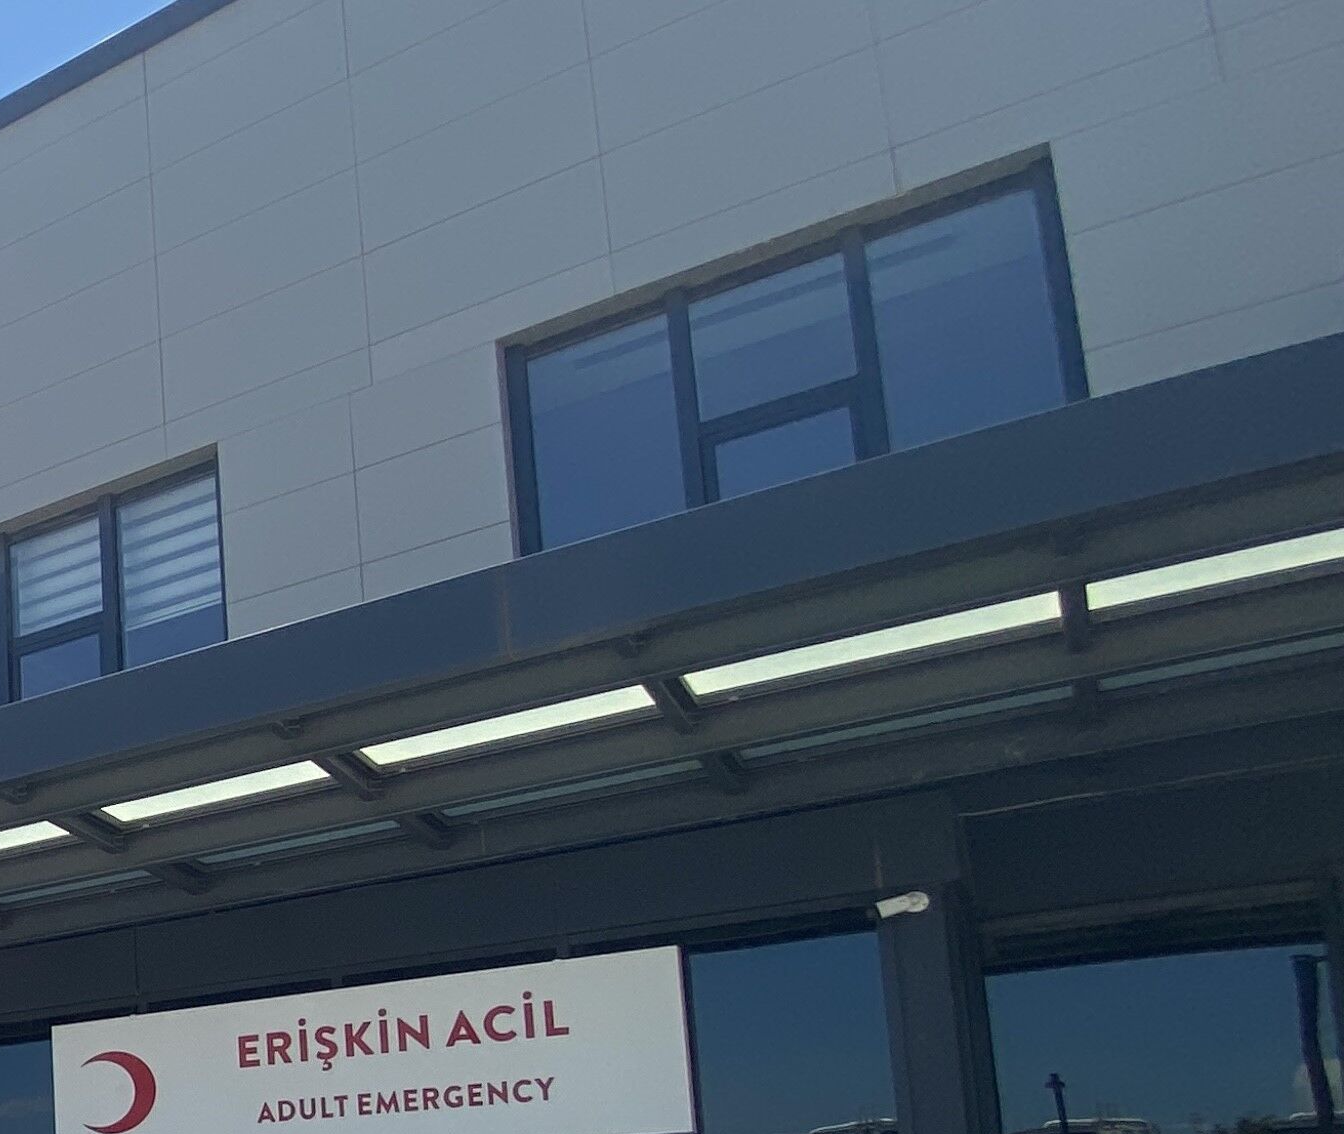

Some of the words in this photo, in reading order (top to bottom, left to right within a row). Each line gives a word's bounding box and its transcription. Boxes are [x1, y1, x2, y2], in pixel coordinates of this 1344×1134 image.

[238, 1008, 431, 1072] ERİŞKİN
[446, 991, 570, 1048] ACİL
[257, 1094, 349, 1124] ADULT
[357, 1077, 555, 1116] EMERGENCY
